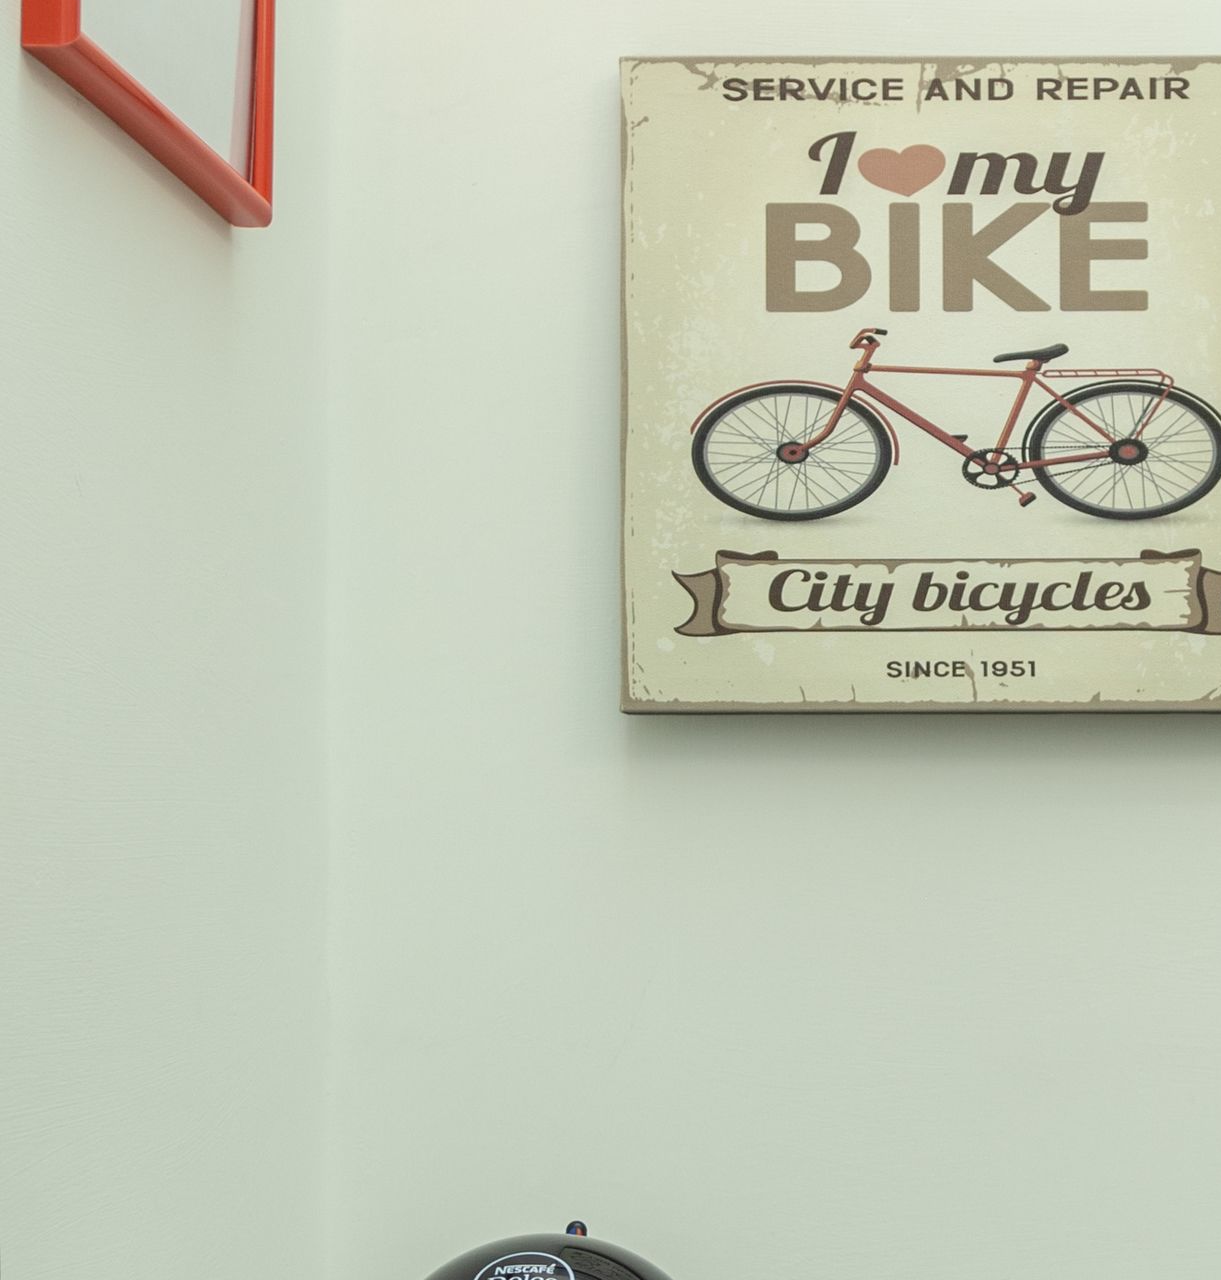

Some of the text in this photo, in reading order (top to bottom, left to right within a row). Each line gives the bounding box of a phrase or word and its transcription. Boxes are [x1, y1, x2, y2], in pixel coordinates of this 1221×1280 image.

[722, 76, 1192, 102] SERVICE AND REPAIR
[807, 130, 1106, 217] I my
[765, 201, 1149, 313] BIKE
[767, 568, 1152, 626] City bicycles
[886, 659, 1037, 678] SINCE 1951
